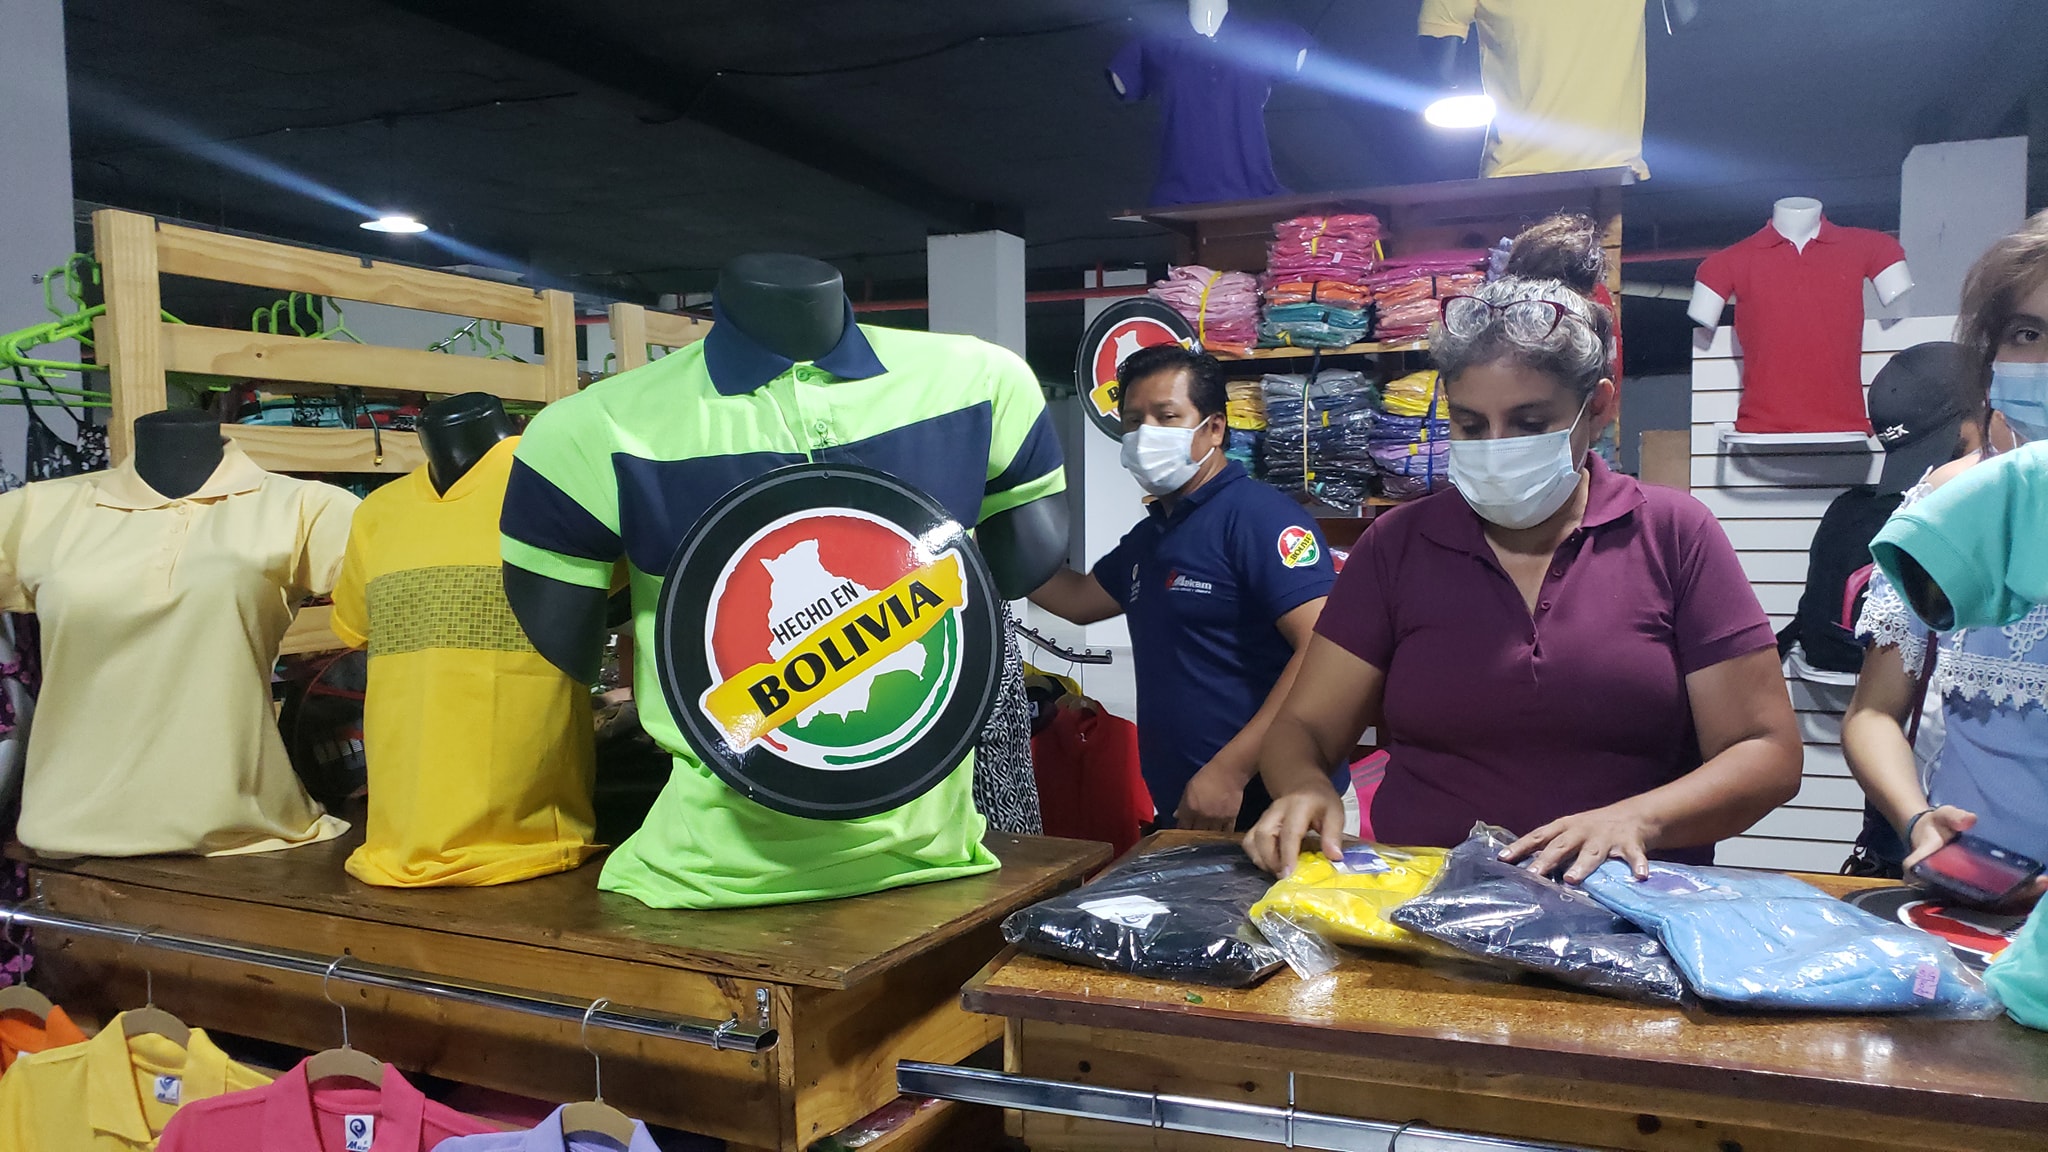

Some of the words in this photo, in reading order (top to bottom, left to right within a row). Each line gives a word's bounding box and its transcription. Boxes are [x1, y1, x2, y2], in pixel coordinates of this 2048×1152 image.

[747, 579, 944, 718] BOLIVIA
[772, 597, 832, 646] HECHO
[831, 581, 859, 608] EN
